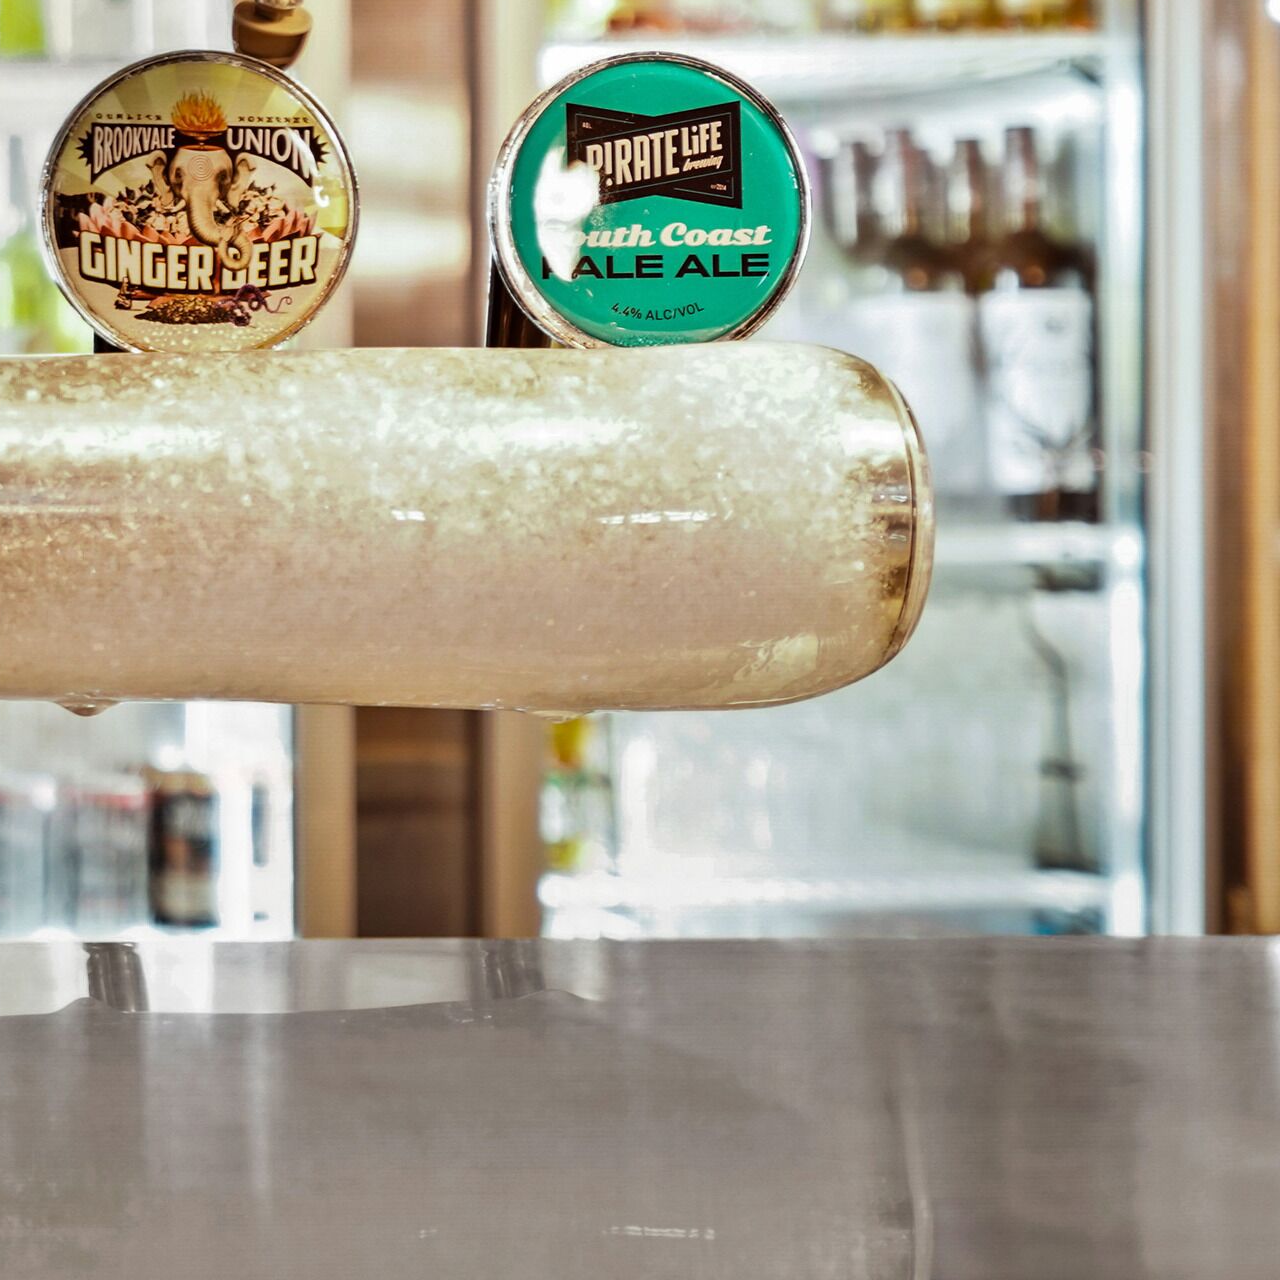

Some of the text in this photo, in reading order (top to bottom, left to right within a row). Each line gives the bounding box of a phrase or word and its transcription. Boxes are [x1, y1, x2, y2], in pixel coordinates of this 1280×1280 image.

[93, 126, 312, 180] BROOKVALE UNION
[682, 155, 724, 172] brewing
[570, 222, 773, 248] outh Coast
[79, 231, 215, 291] GINGER
[675, 253, 771, 279] ALE
[611, 302, 705, 321] 4.4% ALC/VOL
